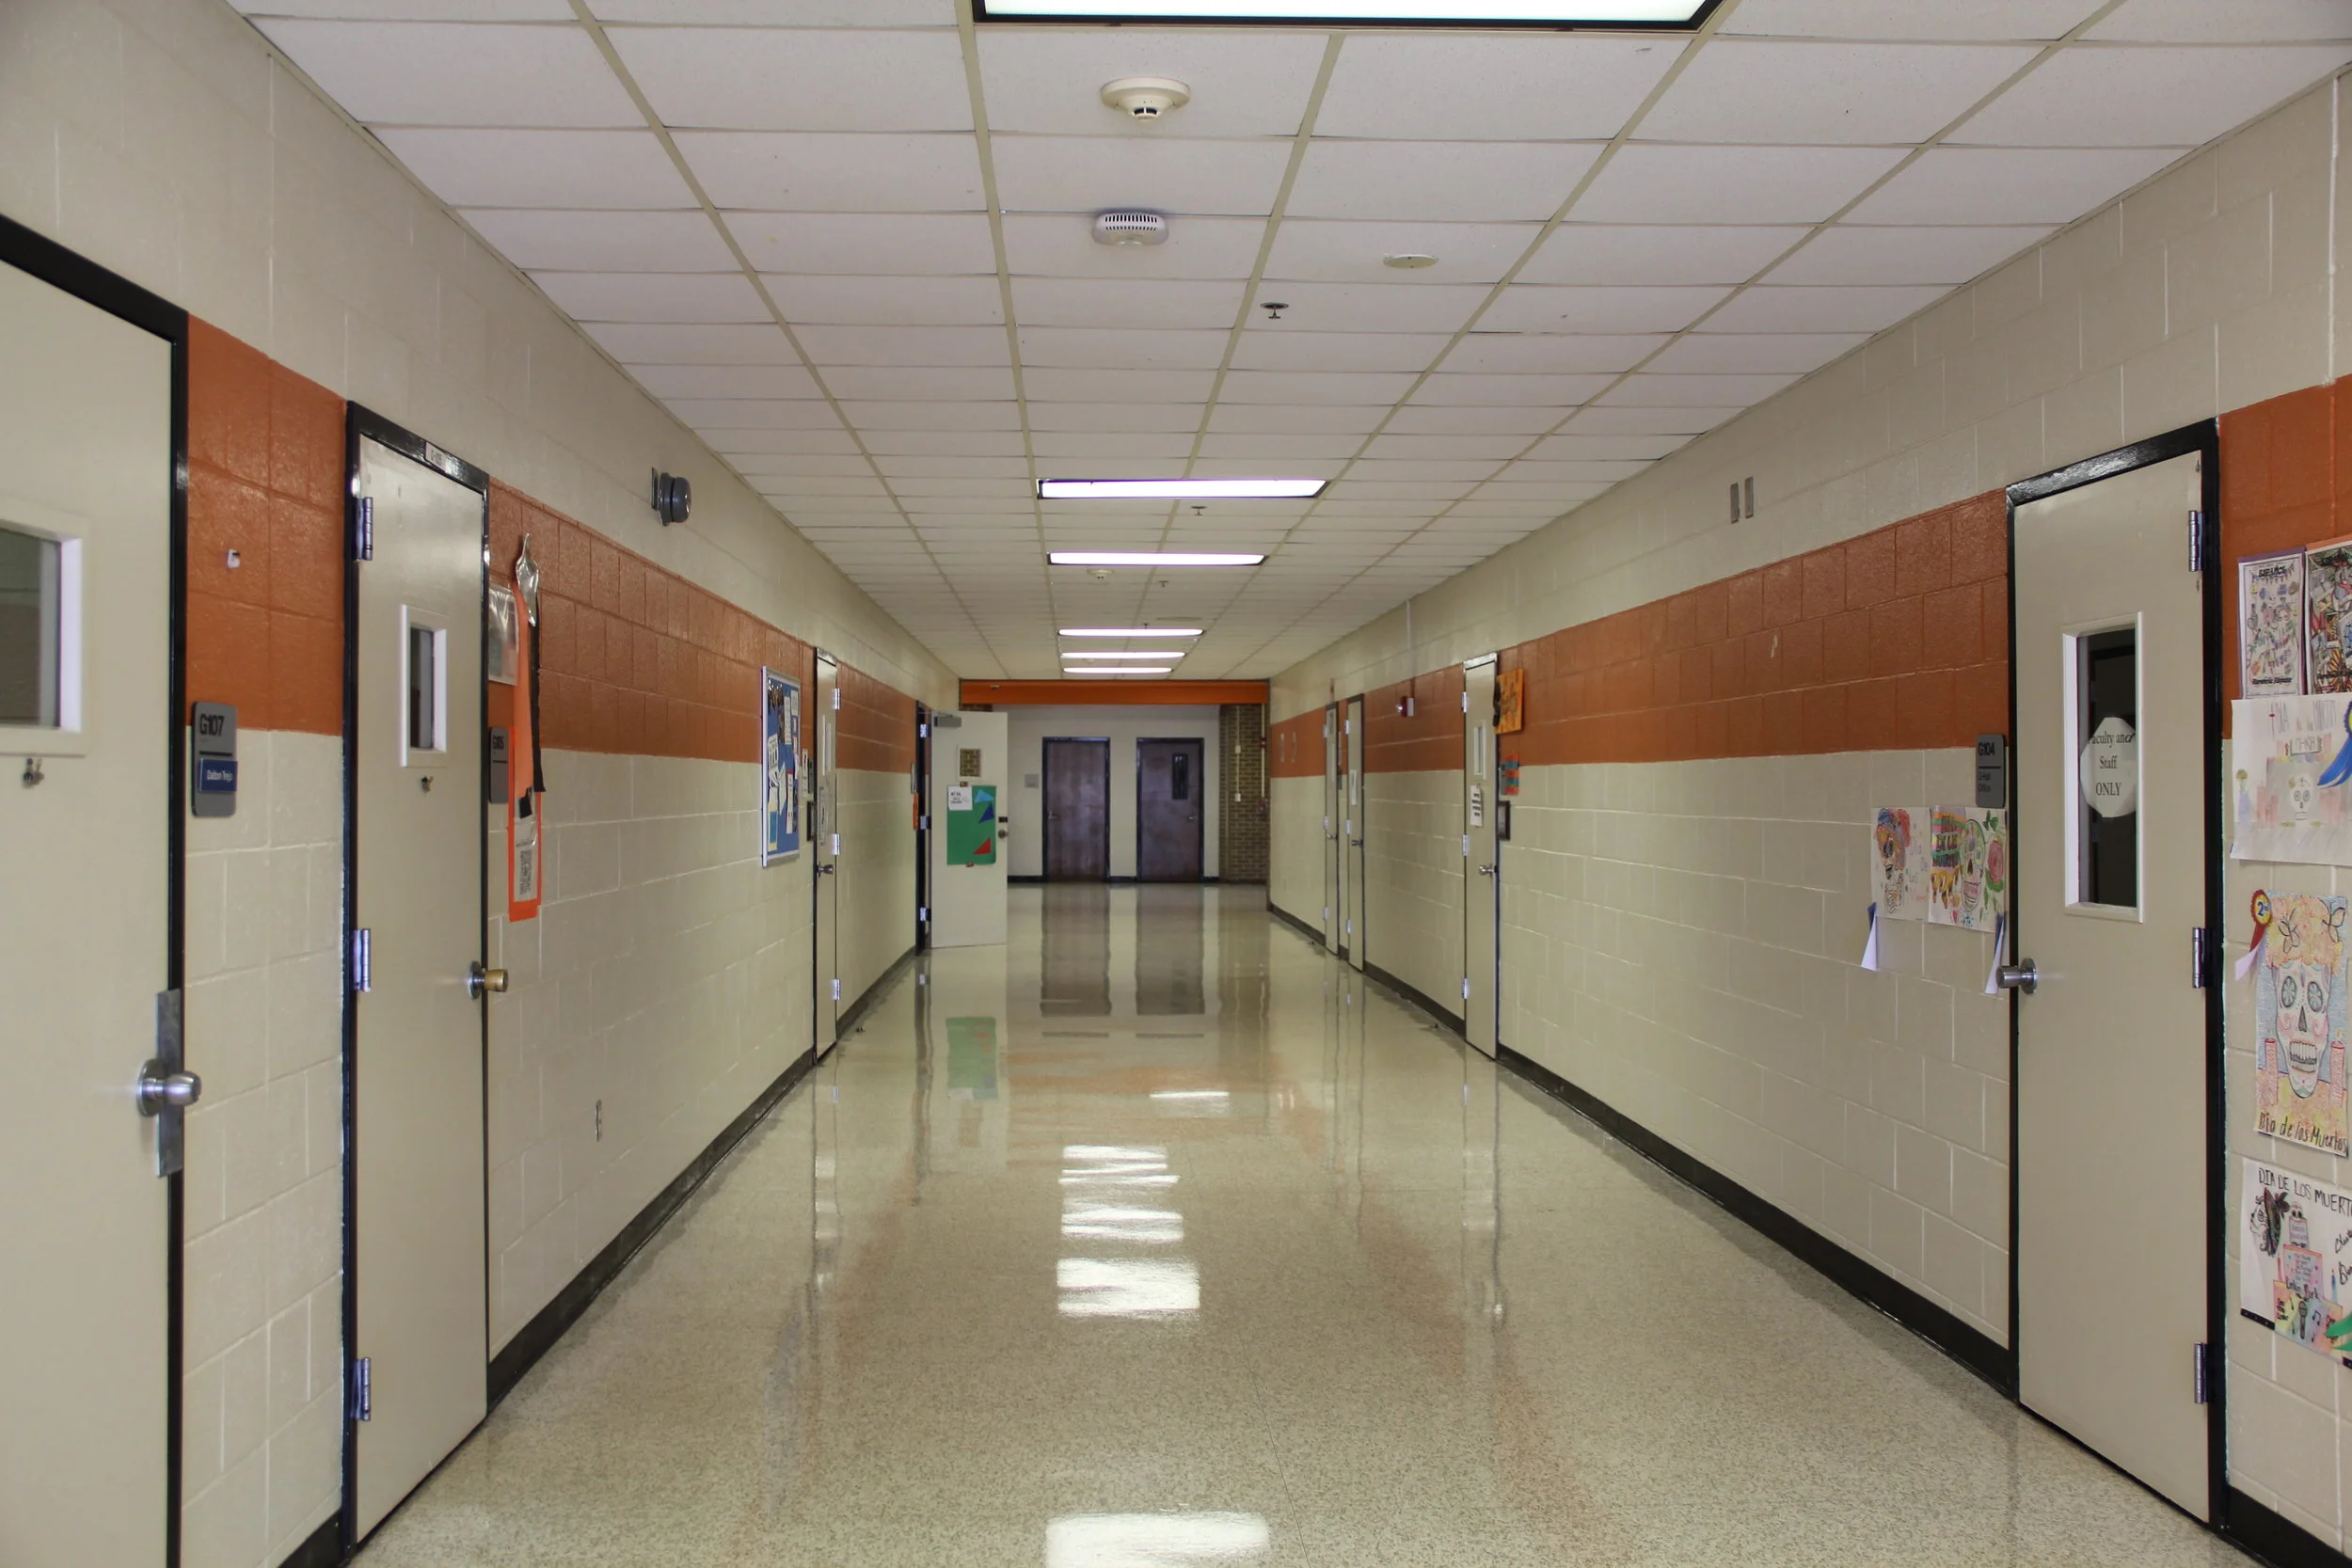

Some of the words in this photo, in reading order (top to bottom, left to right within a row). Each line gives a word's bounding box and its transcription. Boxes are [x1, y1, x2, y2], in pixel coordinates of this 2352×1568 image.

[199, 713, 224, 736] G107
[2090, 732, 2114, 748] aculty
[2116, 733, 2135, 743] and
[2099, 755, 2118, 769] Staff
[2095, 782, 2122, 796] ONLY
[2280, 1116, 2293, 1137] de
[2295, 1121, 2309, 1142] los
[2311, 1125, 2348, 1152] Muertos
[2259, 1167, 2275, 1186] DIA
[2278, 1175, 2290, 1191] DE
[2294, 1180, 2312, 1200] LOS
